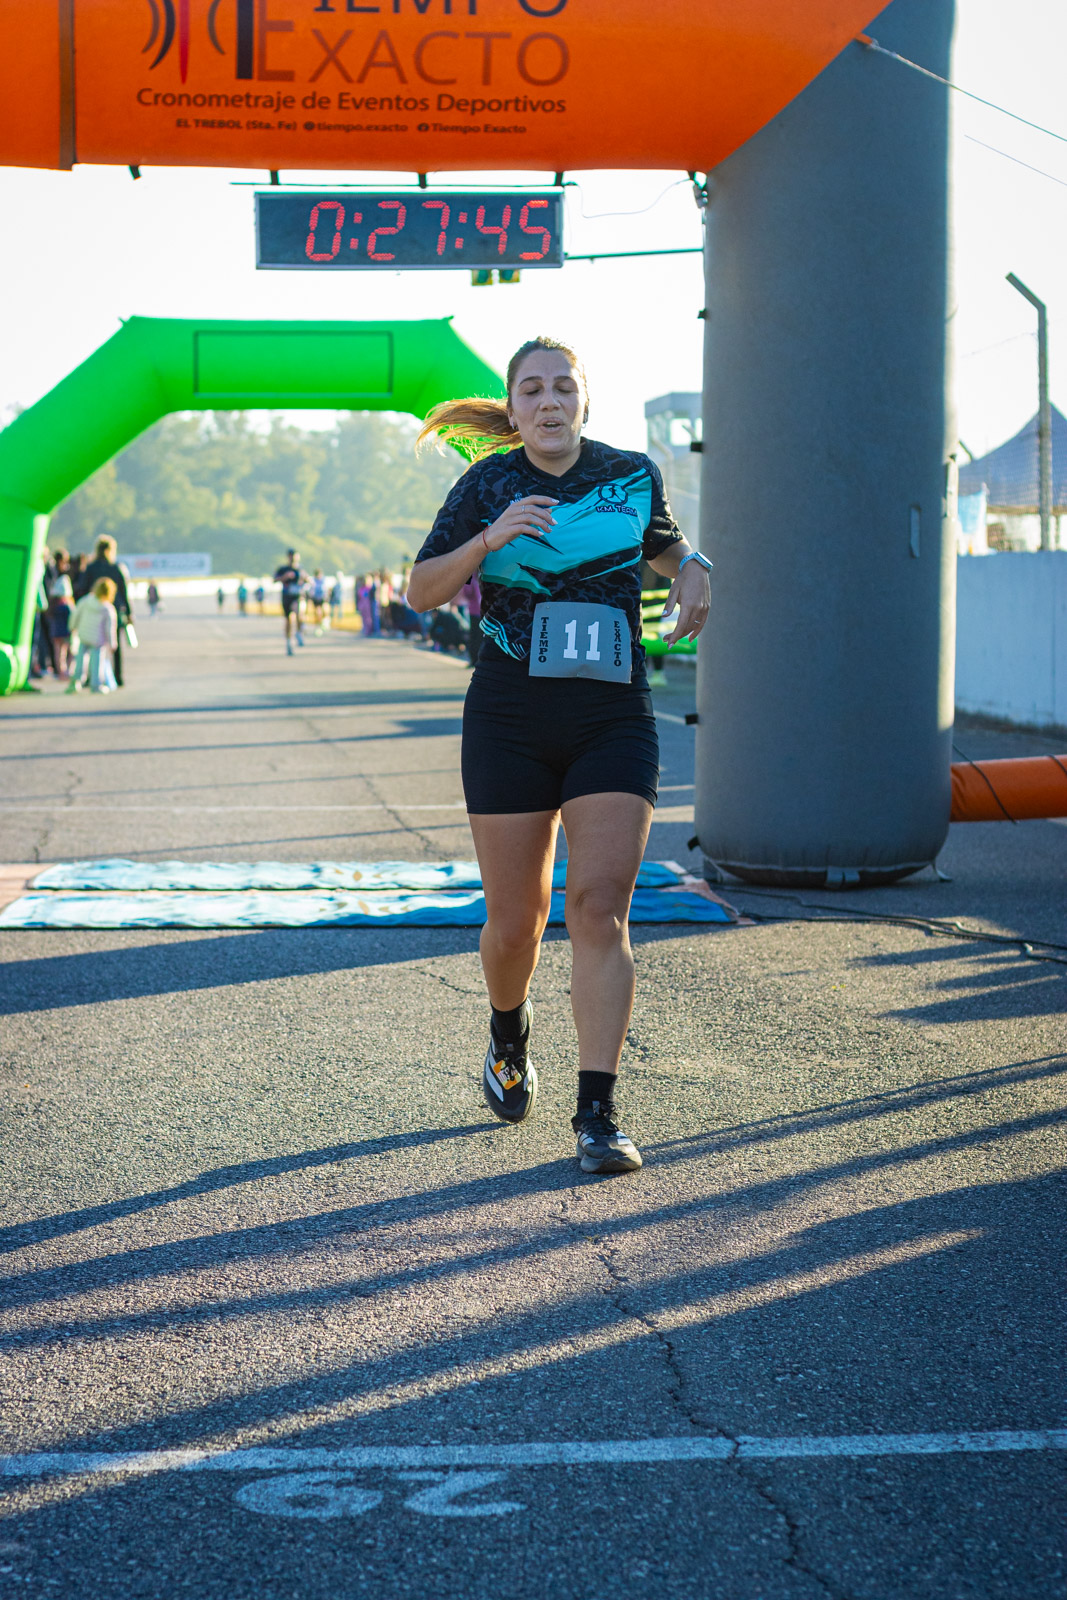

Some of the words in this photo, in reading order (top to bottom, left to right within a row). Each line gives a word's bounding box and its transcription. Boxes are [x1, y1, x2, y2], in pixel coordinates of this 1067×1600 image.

[136, 87, 296, 112] Cronometraje
[301, 91, 331, 110] de
[337, 92, 430, 112] Eventos
[436, 93, 567, 116] Deportivos
[176, 118, 191, 128] EL
[194, 118, 243, 130] TREBOL
[246, 119, 275, 131] (Sta.
[278, 120, 298, 131] Fe)
[432, 123, 481, 134] Tiempo
[483, 123, 527, 134] Exacto
[305, 200, 551, 261] 0:27:45
[538, 616, 550, 664] TIEMPO
[563, 619, 601, 662] 11
[613, 620, 623, 668] EXACTO
